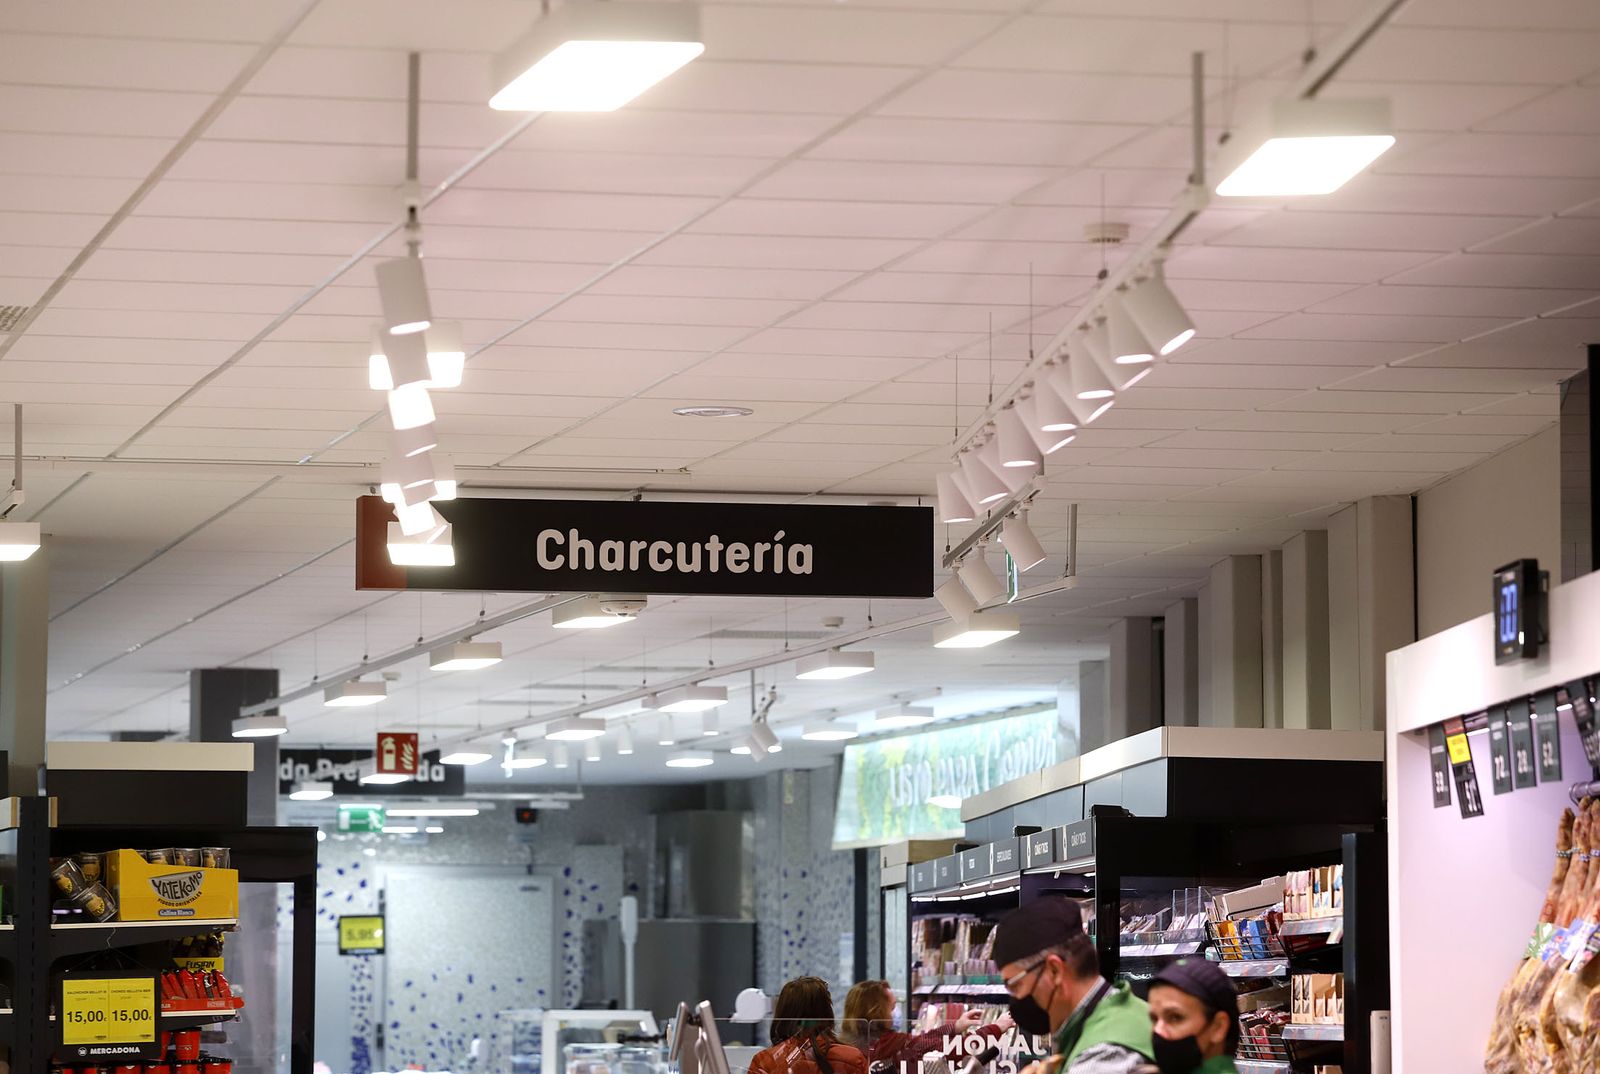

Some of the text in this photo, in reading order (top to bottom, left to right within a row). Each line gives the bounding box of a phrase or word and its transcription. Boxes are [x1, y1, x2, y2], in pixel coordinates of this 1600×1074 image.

[535, 528, 814, 575] Charcutería
[151, 871, 203, 900] YATEKOMO
[90, 1046, 141, 1055] MERCADONA
